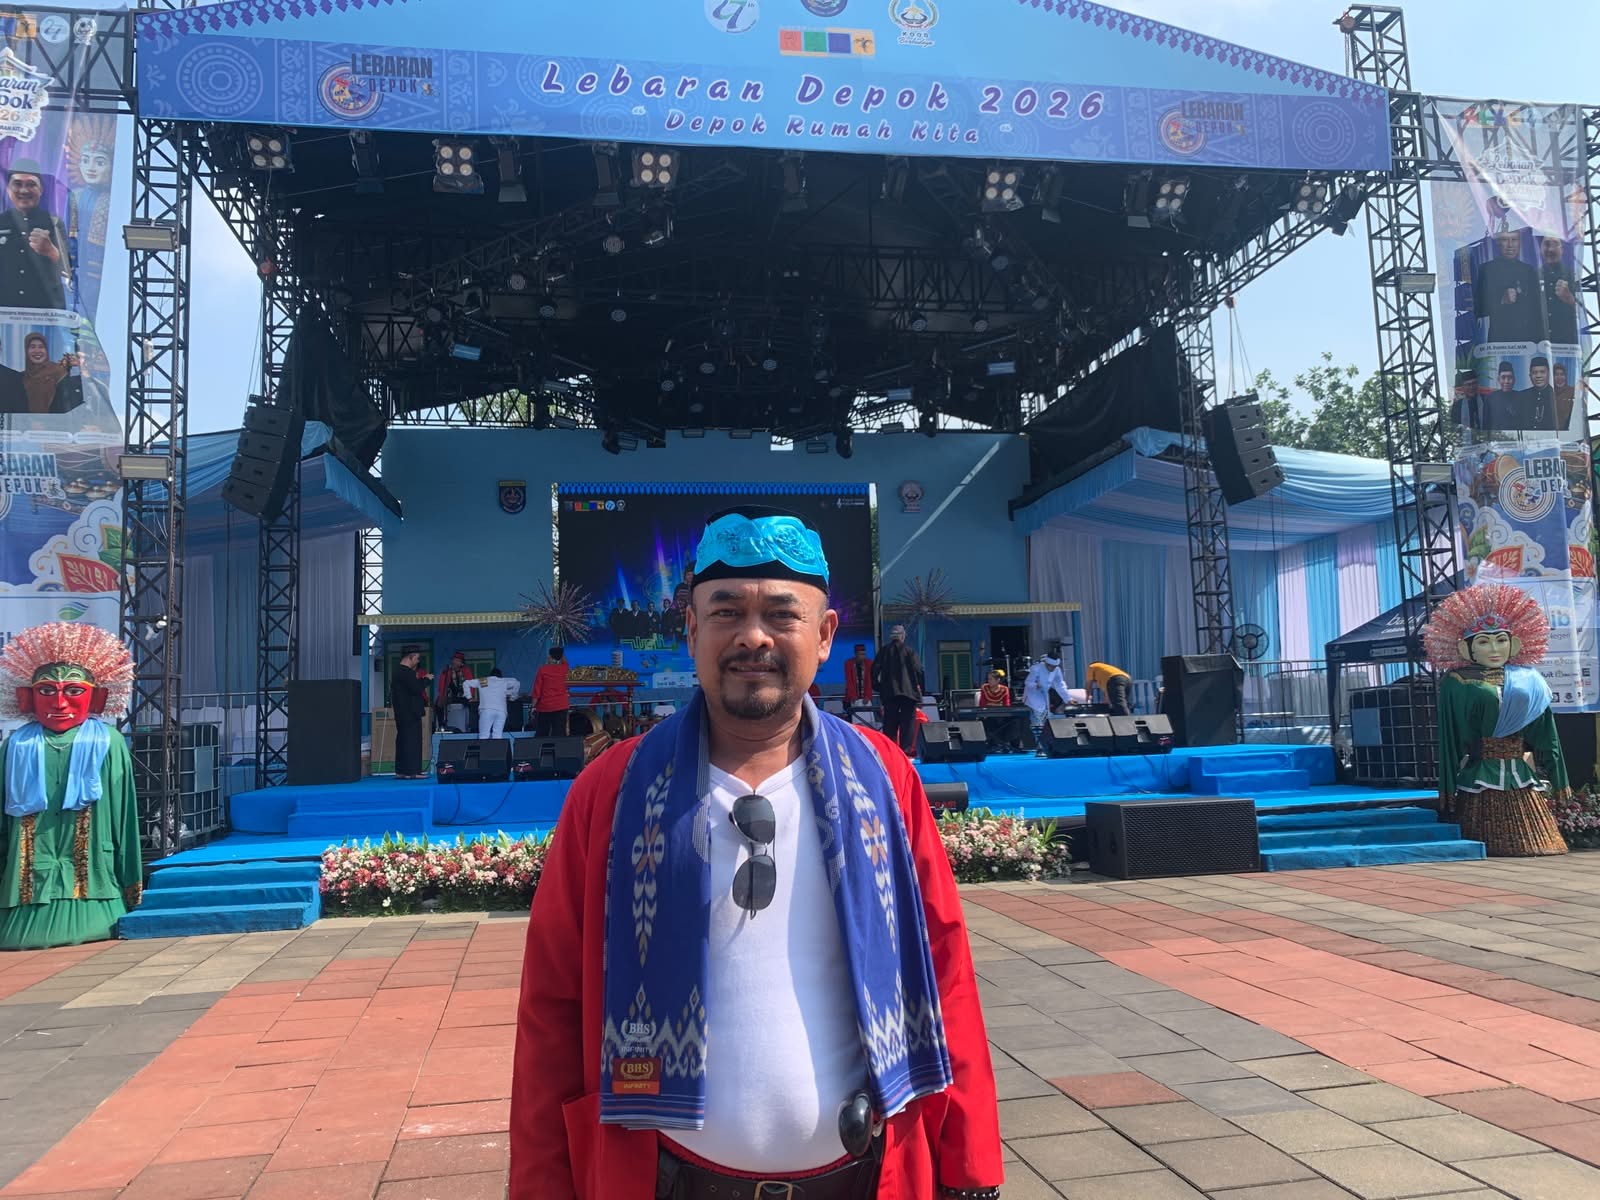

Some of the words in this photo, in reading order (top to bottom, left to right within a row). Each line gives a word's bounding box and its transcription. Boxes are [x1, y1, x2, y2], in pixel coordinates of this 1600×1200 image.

[351, 53, 433, 79] LEBARAN
[369, 78, 417, 93] DEPOK
[542, 62, 764, 102] Lebaran
[796, 73, 950, 113] Depok
[979, 86, 1105, 120] 2026
[1181, 100, 1245, 120] LEBARAN
[665, 108, 768, 137] Depok
[786, 115, 893, 141] Rumah
[911, 121, 980, 145] Kita
[629, 1023, 650, 1034] BHS
[626, 1063, 650, 1073] BHS
